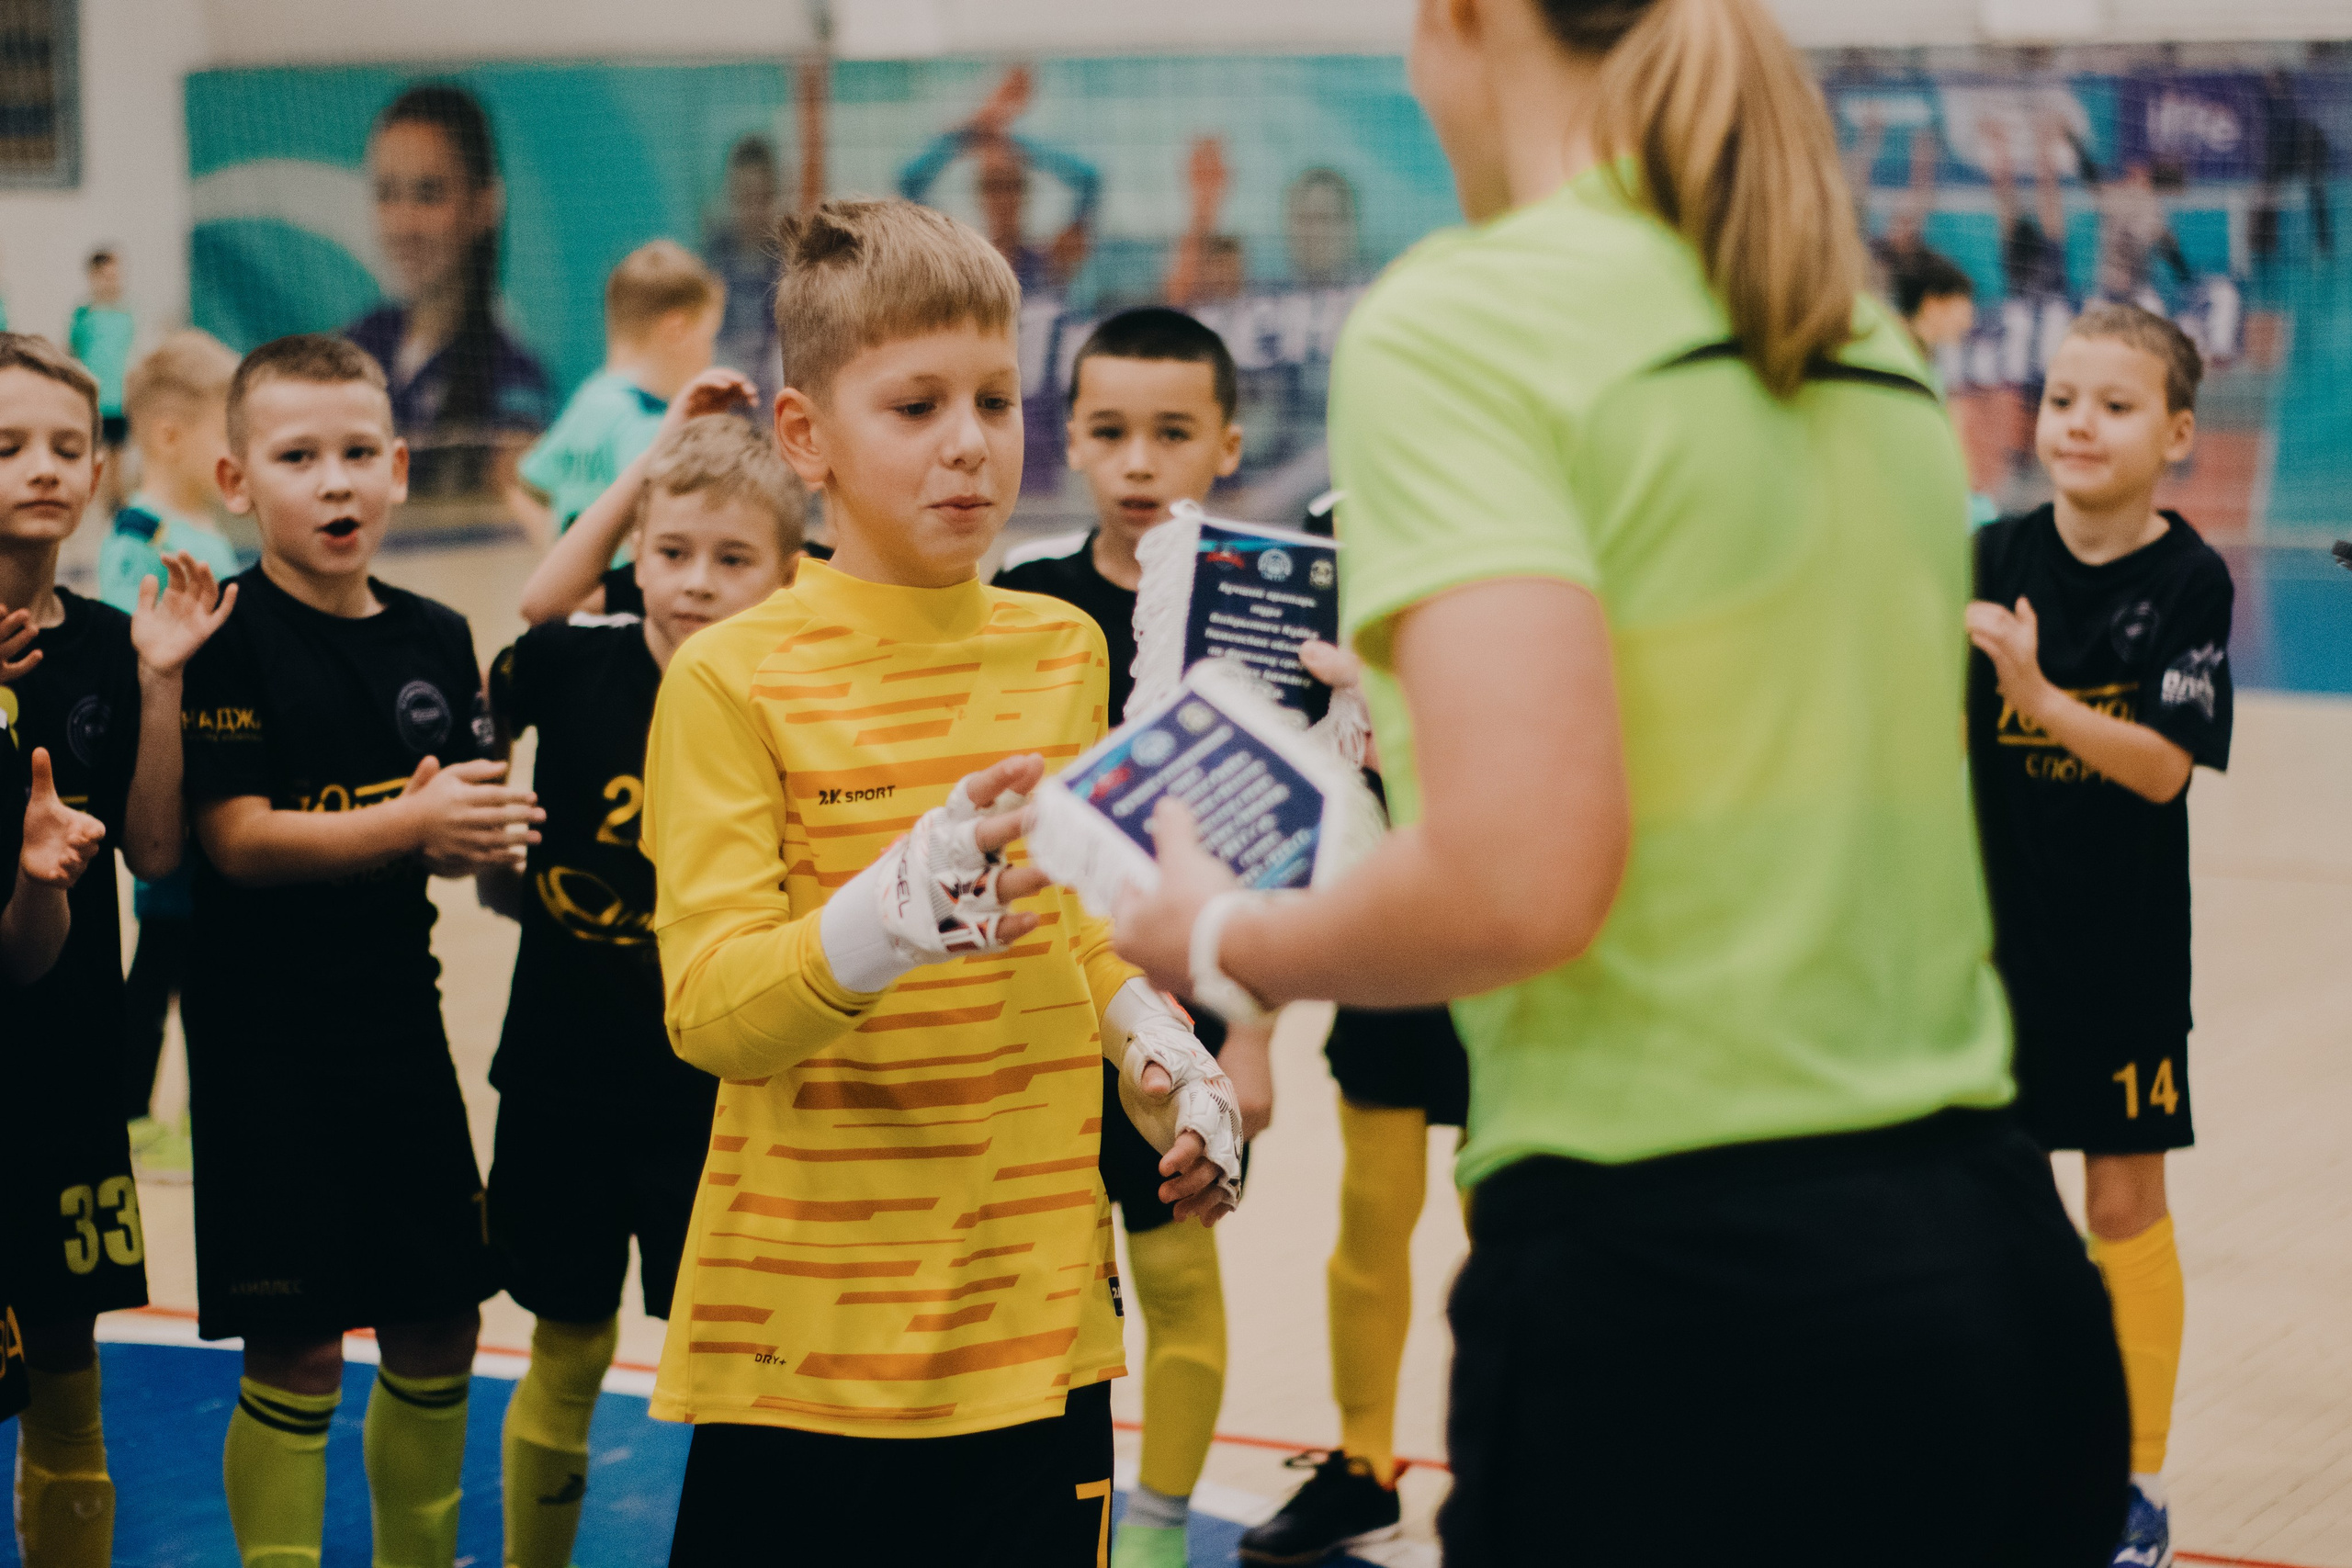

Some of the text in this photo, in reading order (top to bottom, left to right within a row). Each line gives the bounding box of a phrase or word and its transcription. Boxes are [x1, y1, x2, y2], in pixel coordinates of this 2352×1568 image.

[845, 784, 896, 803] SPORT
[2112, 1056, 2180, 1120] 14
[60, 1175, 144, 1275] 33
